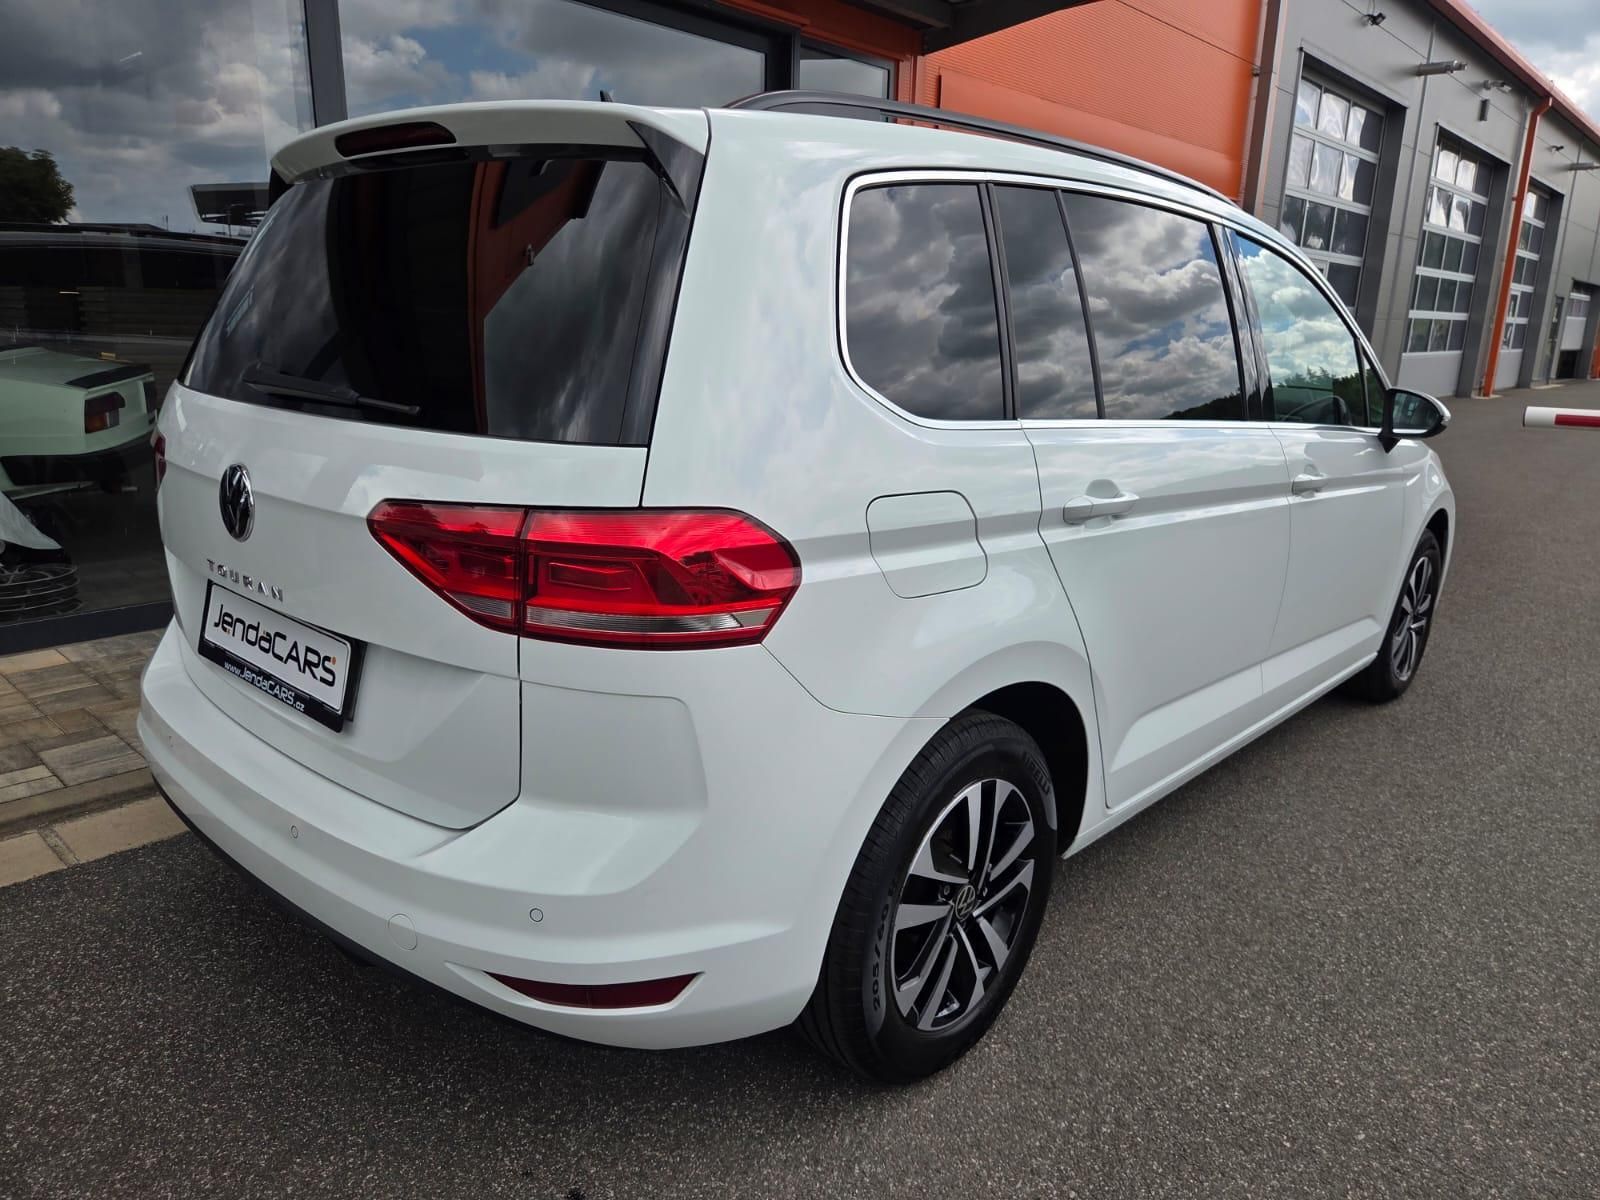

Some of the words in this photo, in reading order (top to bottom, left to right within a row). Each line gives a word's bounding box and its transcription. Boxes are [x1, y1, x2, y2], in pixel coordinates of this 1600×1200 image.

[206, 558, 283, 602] TOURAN
[213, 603, 336, 688] JendaCARS
[224, 661, 305, 712] www.JendaCARS.cz
